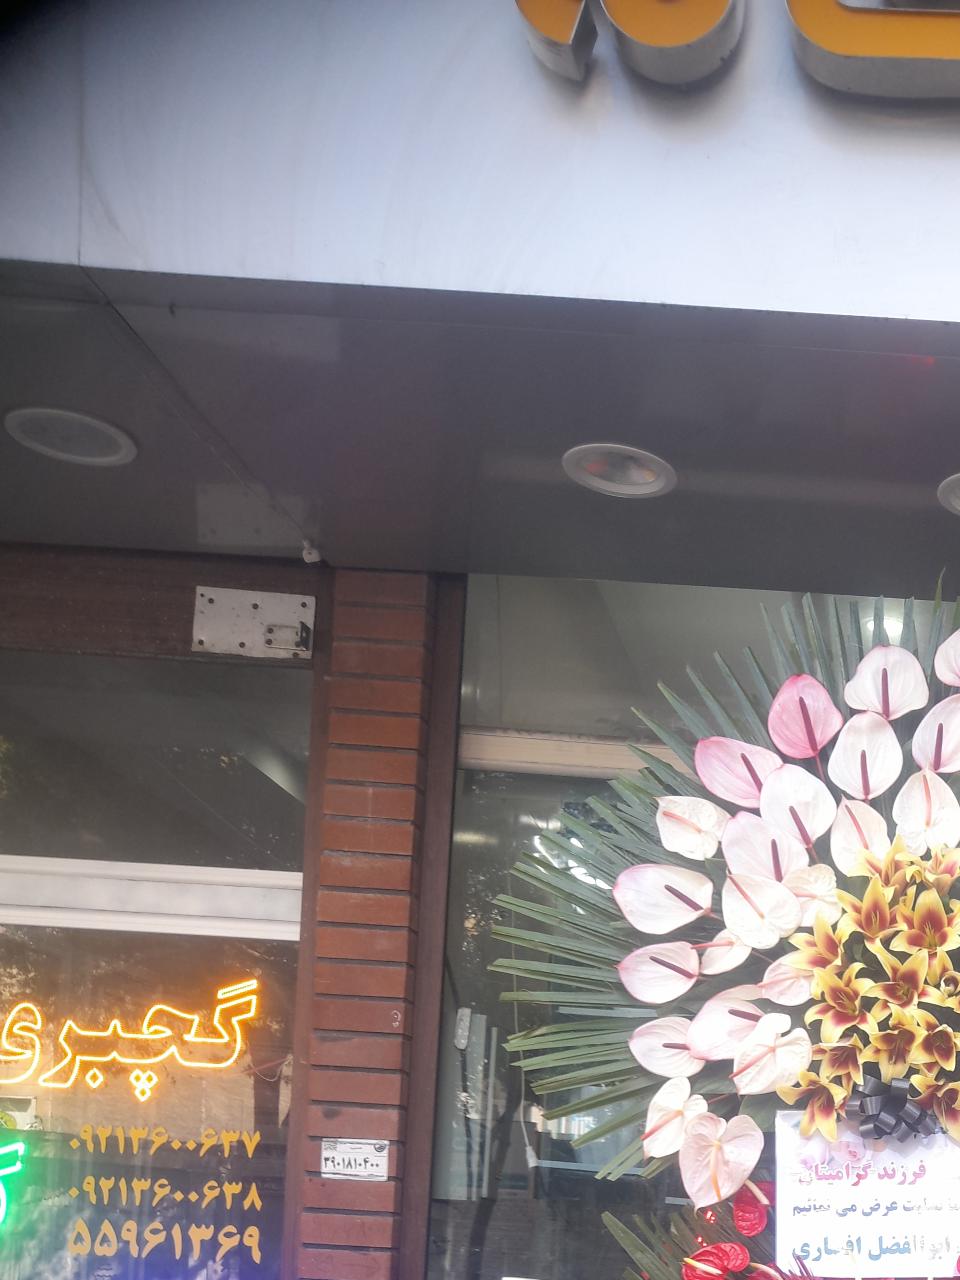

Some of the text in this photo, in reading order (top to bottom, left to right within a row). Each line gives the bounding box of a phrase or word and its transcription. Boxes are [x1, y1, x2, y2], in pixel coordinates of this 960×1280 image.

[0, 979, 258, 1103] گچبری
[69, 1123, 262, 1159] ۰۹۲۱۳۶۰۰۶۳۷
[875, 1159, 927, 1186] فرزند
[68, 1175, 263, 1212] ۰۹۲۱۳۶۰۰۶۳۸
[835, 1203, 858, 1218] می
[861, 1197, 898, 1218] عرض
[67, 1217, 262, 1265] ۵۵۹۶۱۳۶۹
